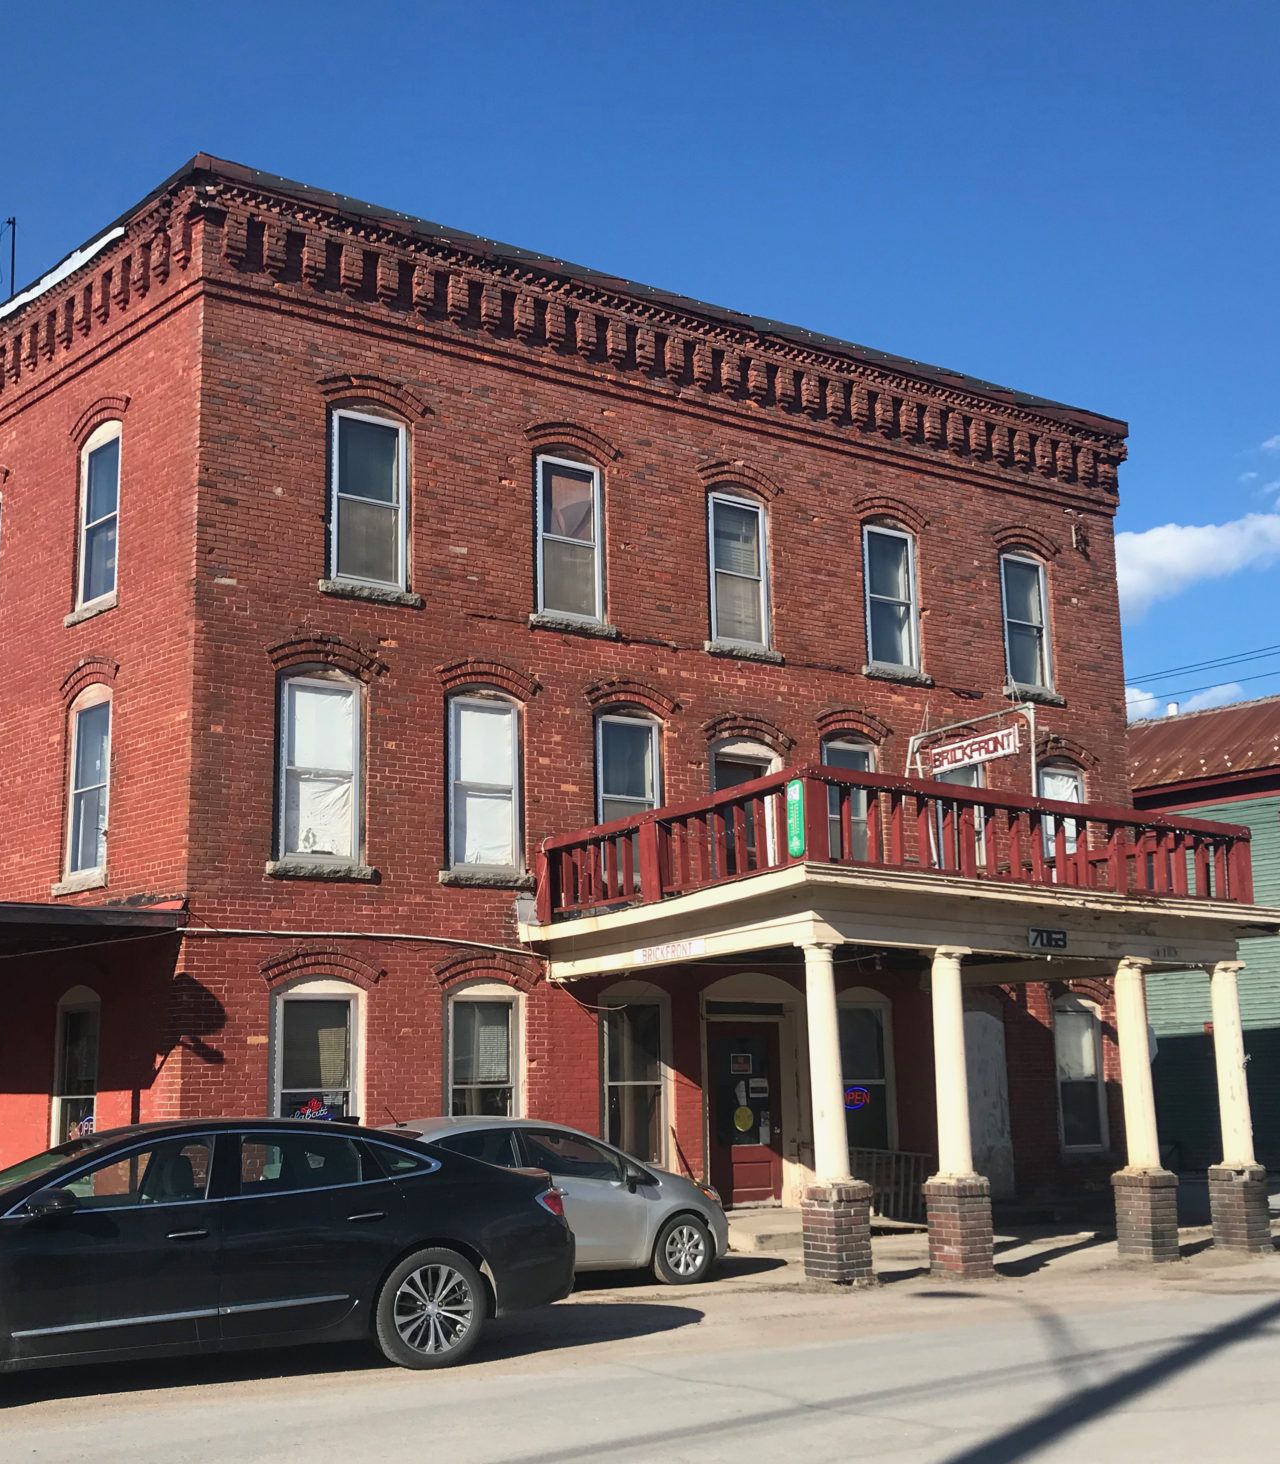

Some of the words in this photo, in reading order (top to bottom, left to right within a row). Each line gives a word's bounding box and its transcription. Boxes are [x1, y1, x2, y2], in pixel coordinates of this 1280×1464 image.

[933, 731, 1013, 769] BRICKFRONT
[642, 941, 693, 962] BRICKFRONT
[844, 1091, 871, 1105] PEN
[79, 1121, 94, 1136] OPE
